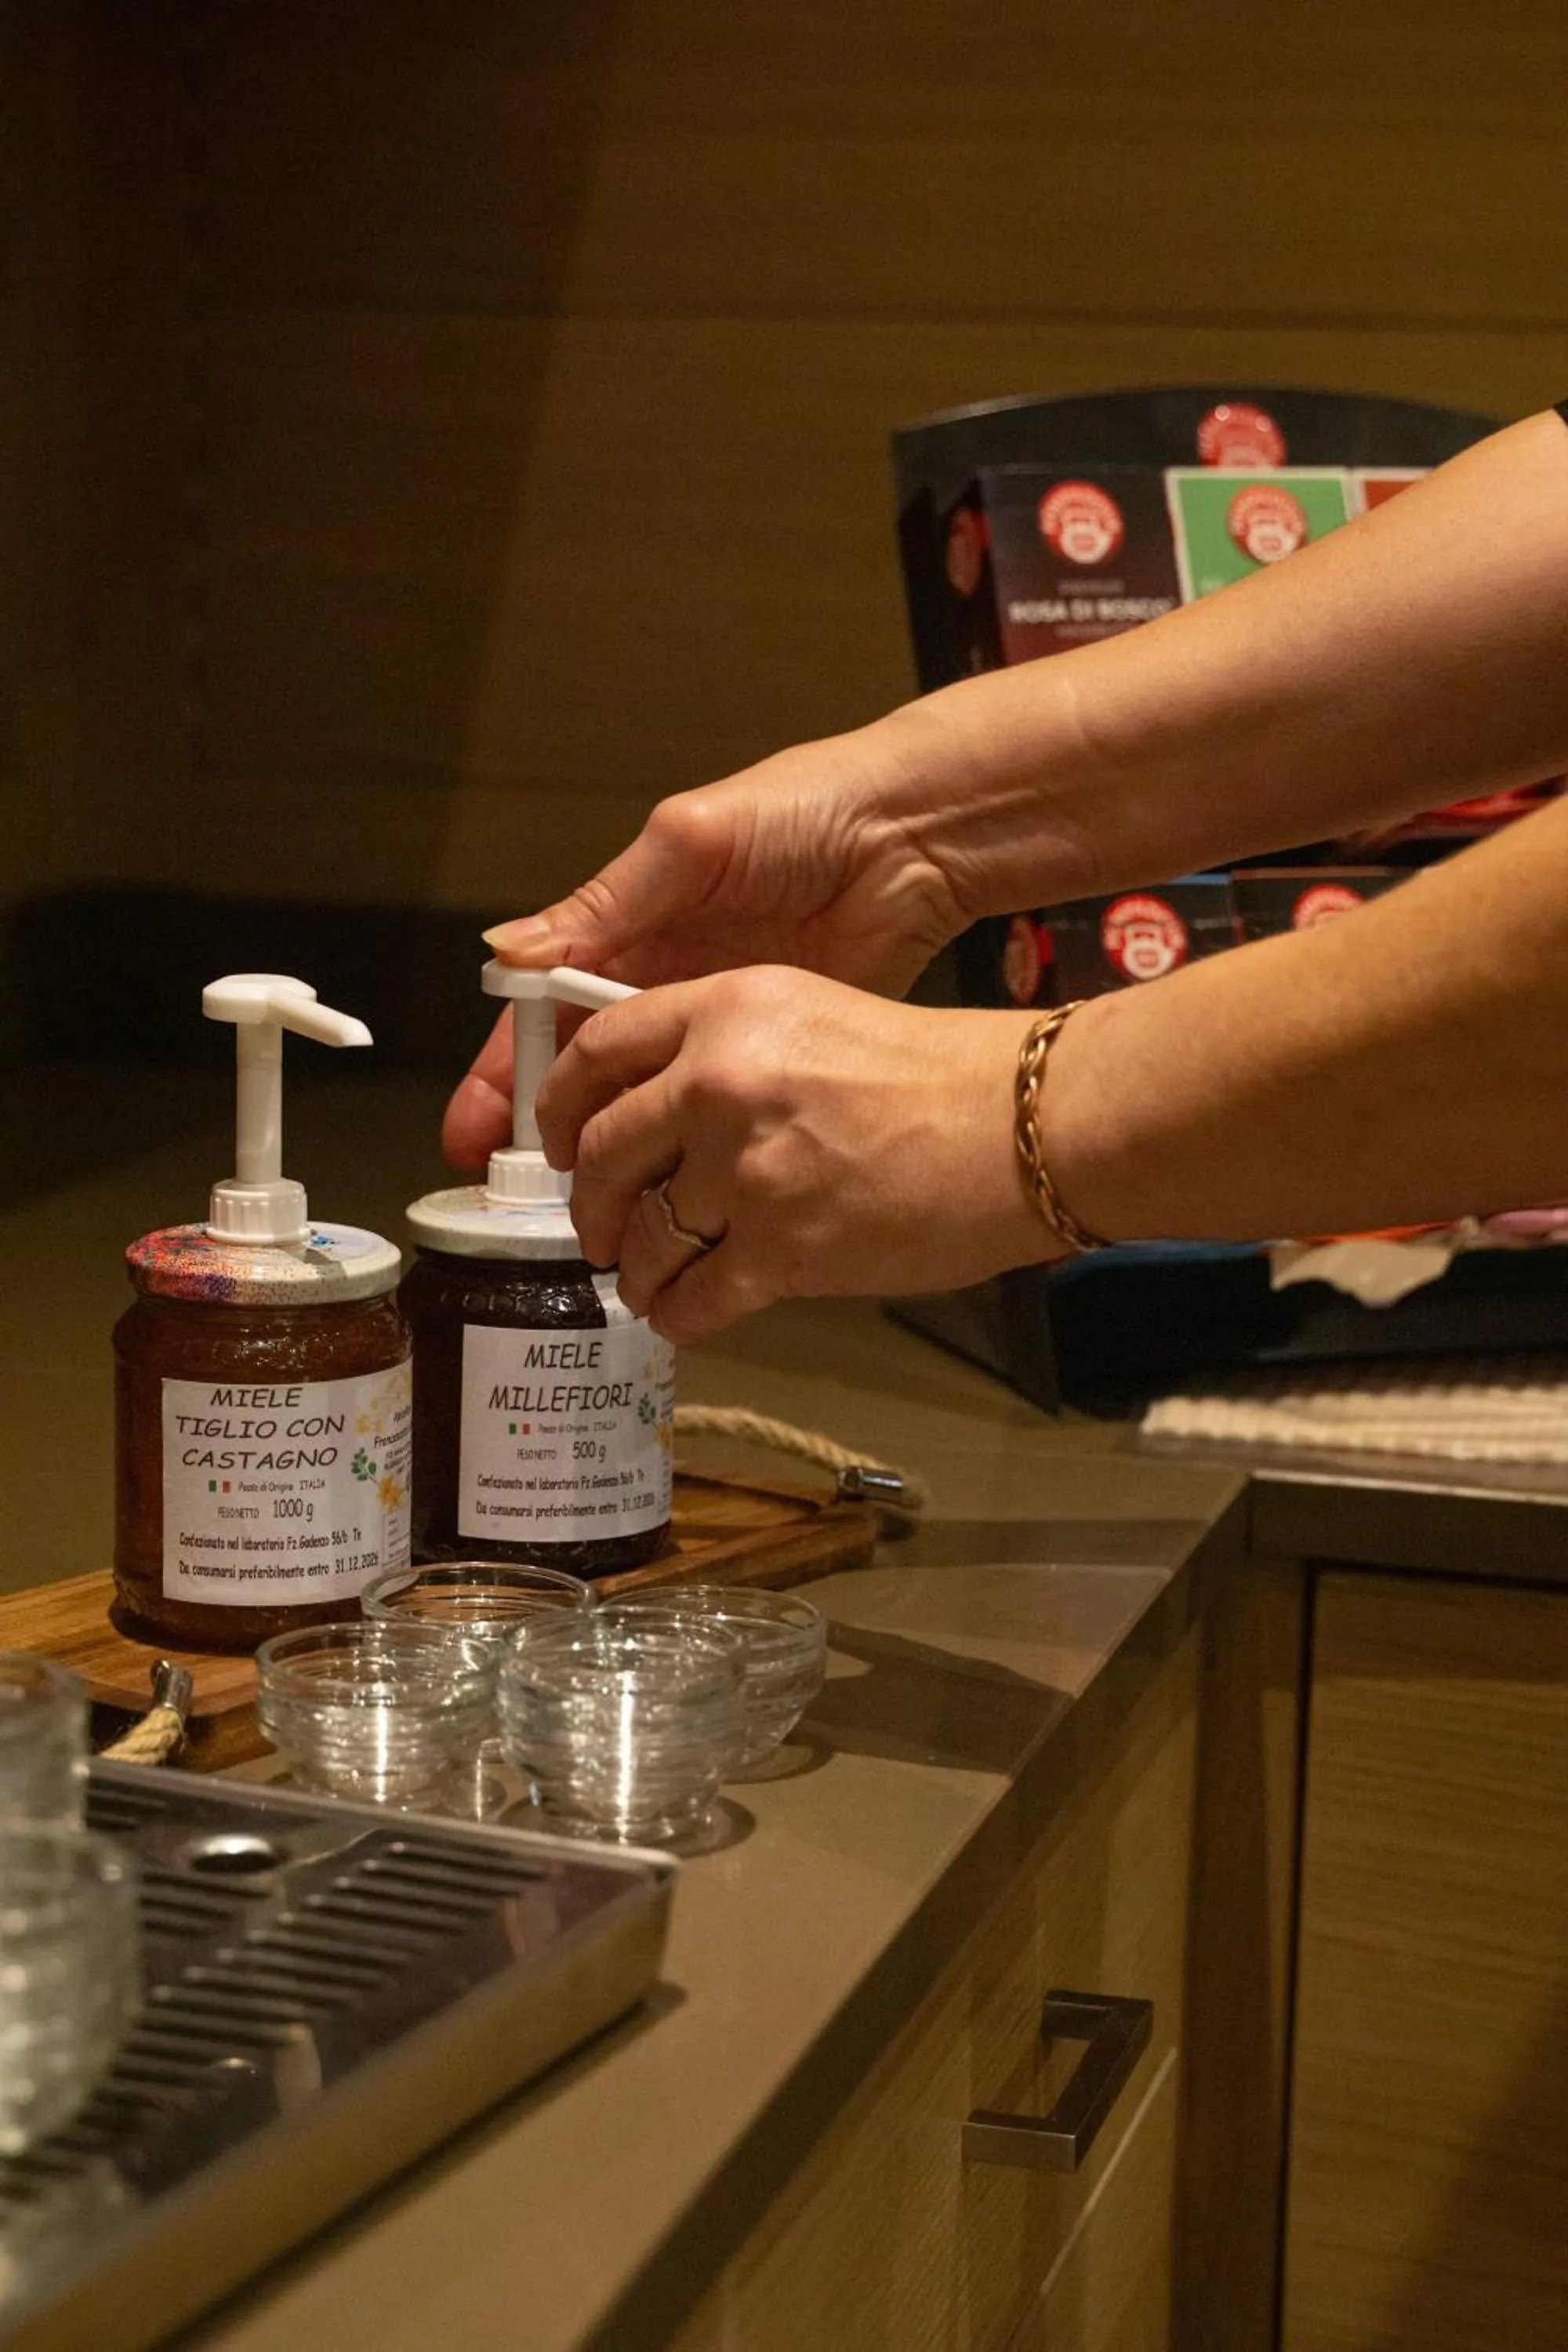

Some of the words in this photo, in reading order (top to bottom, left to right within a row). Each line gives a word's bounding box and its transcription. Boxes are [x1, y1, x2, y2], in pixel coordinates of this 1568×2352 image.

[523, 1342, 602, 1369] MIELE
[210, 1387, 303, 1409] MIELE
[488, 1382, 633, 1412] MILLEFIORI
[176, 1414, 276, 1439] TIGLIO
[287, 1414, 345, 1439] CON
[183, 1447, 338, 1470] CASTAGNO
[572, 1441, 595, 1459] 500
[599, 1445, 606, 1463] g
[273, 1498, 303, 1519] 1000
[306, 1503, 314, 1522] g
[489, 1504, 532, 1517] consumarsi
[535, 1503, 595, 1522] preferibilmente
[180, 1532, 225, 1550] Confezionato
[179, 1560, 190, 1575] Da
[192, 1565, 236, 1578] consumarsi
[239, 1565, 304, 1581] preferibilmente
[307, 1563, 329, 1575] entro
